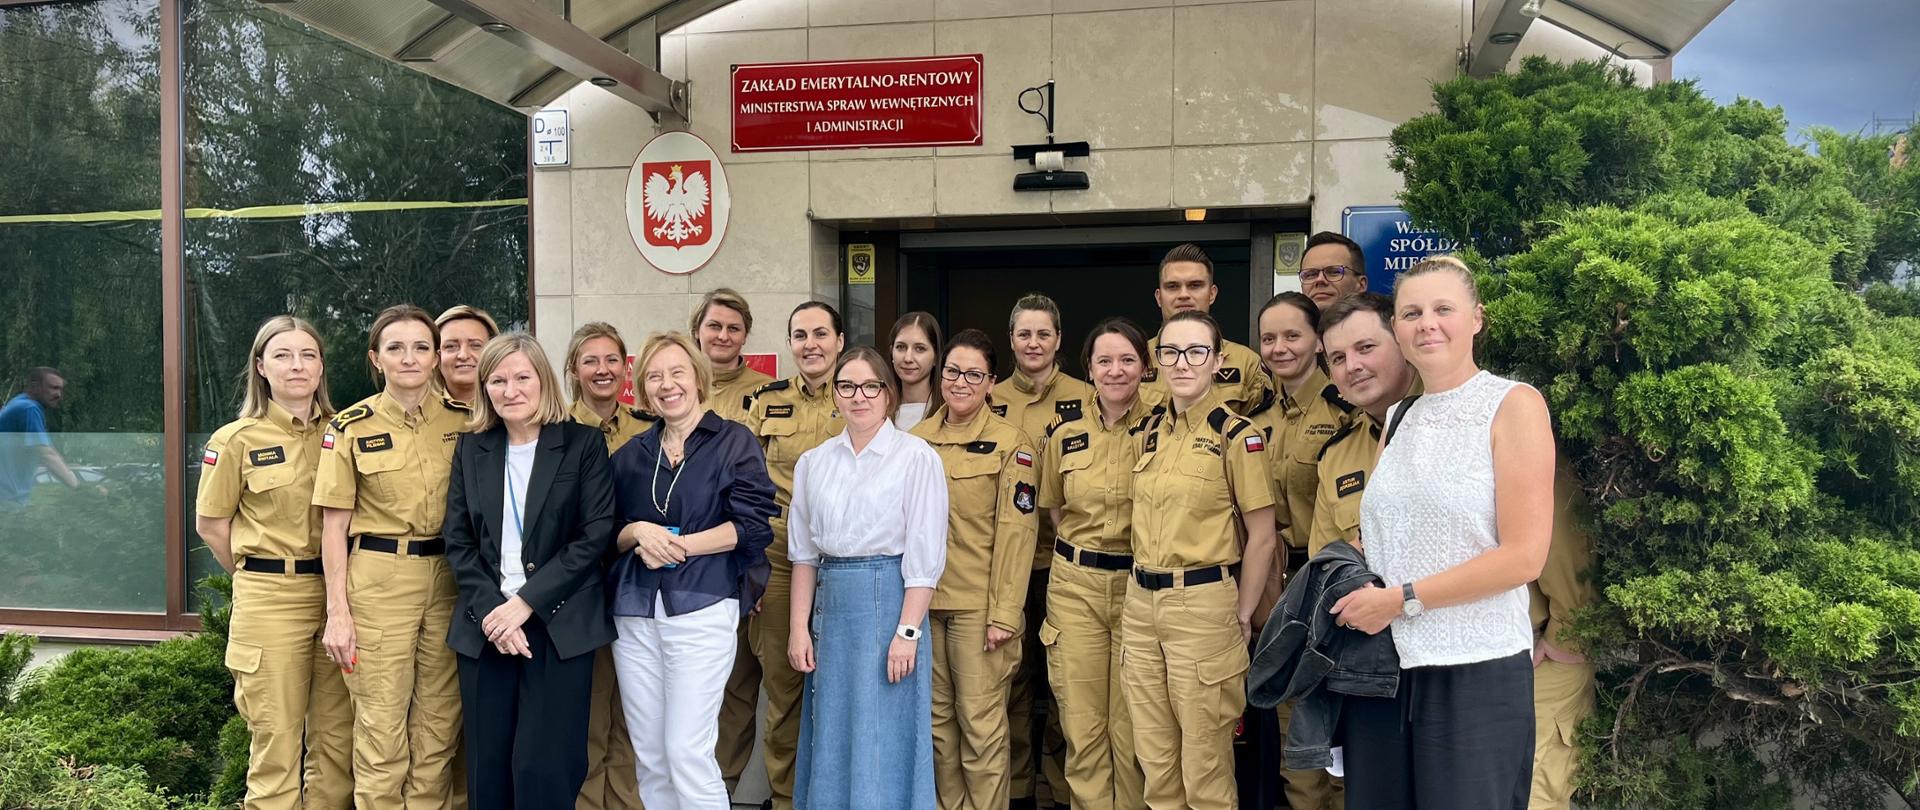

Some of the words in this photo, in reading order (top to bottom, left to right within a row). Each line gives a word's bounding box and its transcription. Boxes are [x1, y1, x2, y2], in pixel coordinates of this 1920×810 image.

[741, 78, 797, 93] ZAKŁAD
[801, 71, 973, 90] EMERYTALNO-RENTOWY
[740, 101, 825, 114] MINISTERSTWA
[827, 99, 867, 112] SPRAW
[870, 95, 974, 111] WEWNĘTRZNYCH
[534, 118, 545, 134] D
[807, 121, 810, 132] I
[813, 119, 904, 132] ADMINISTRACJI
